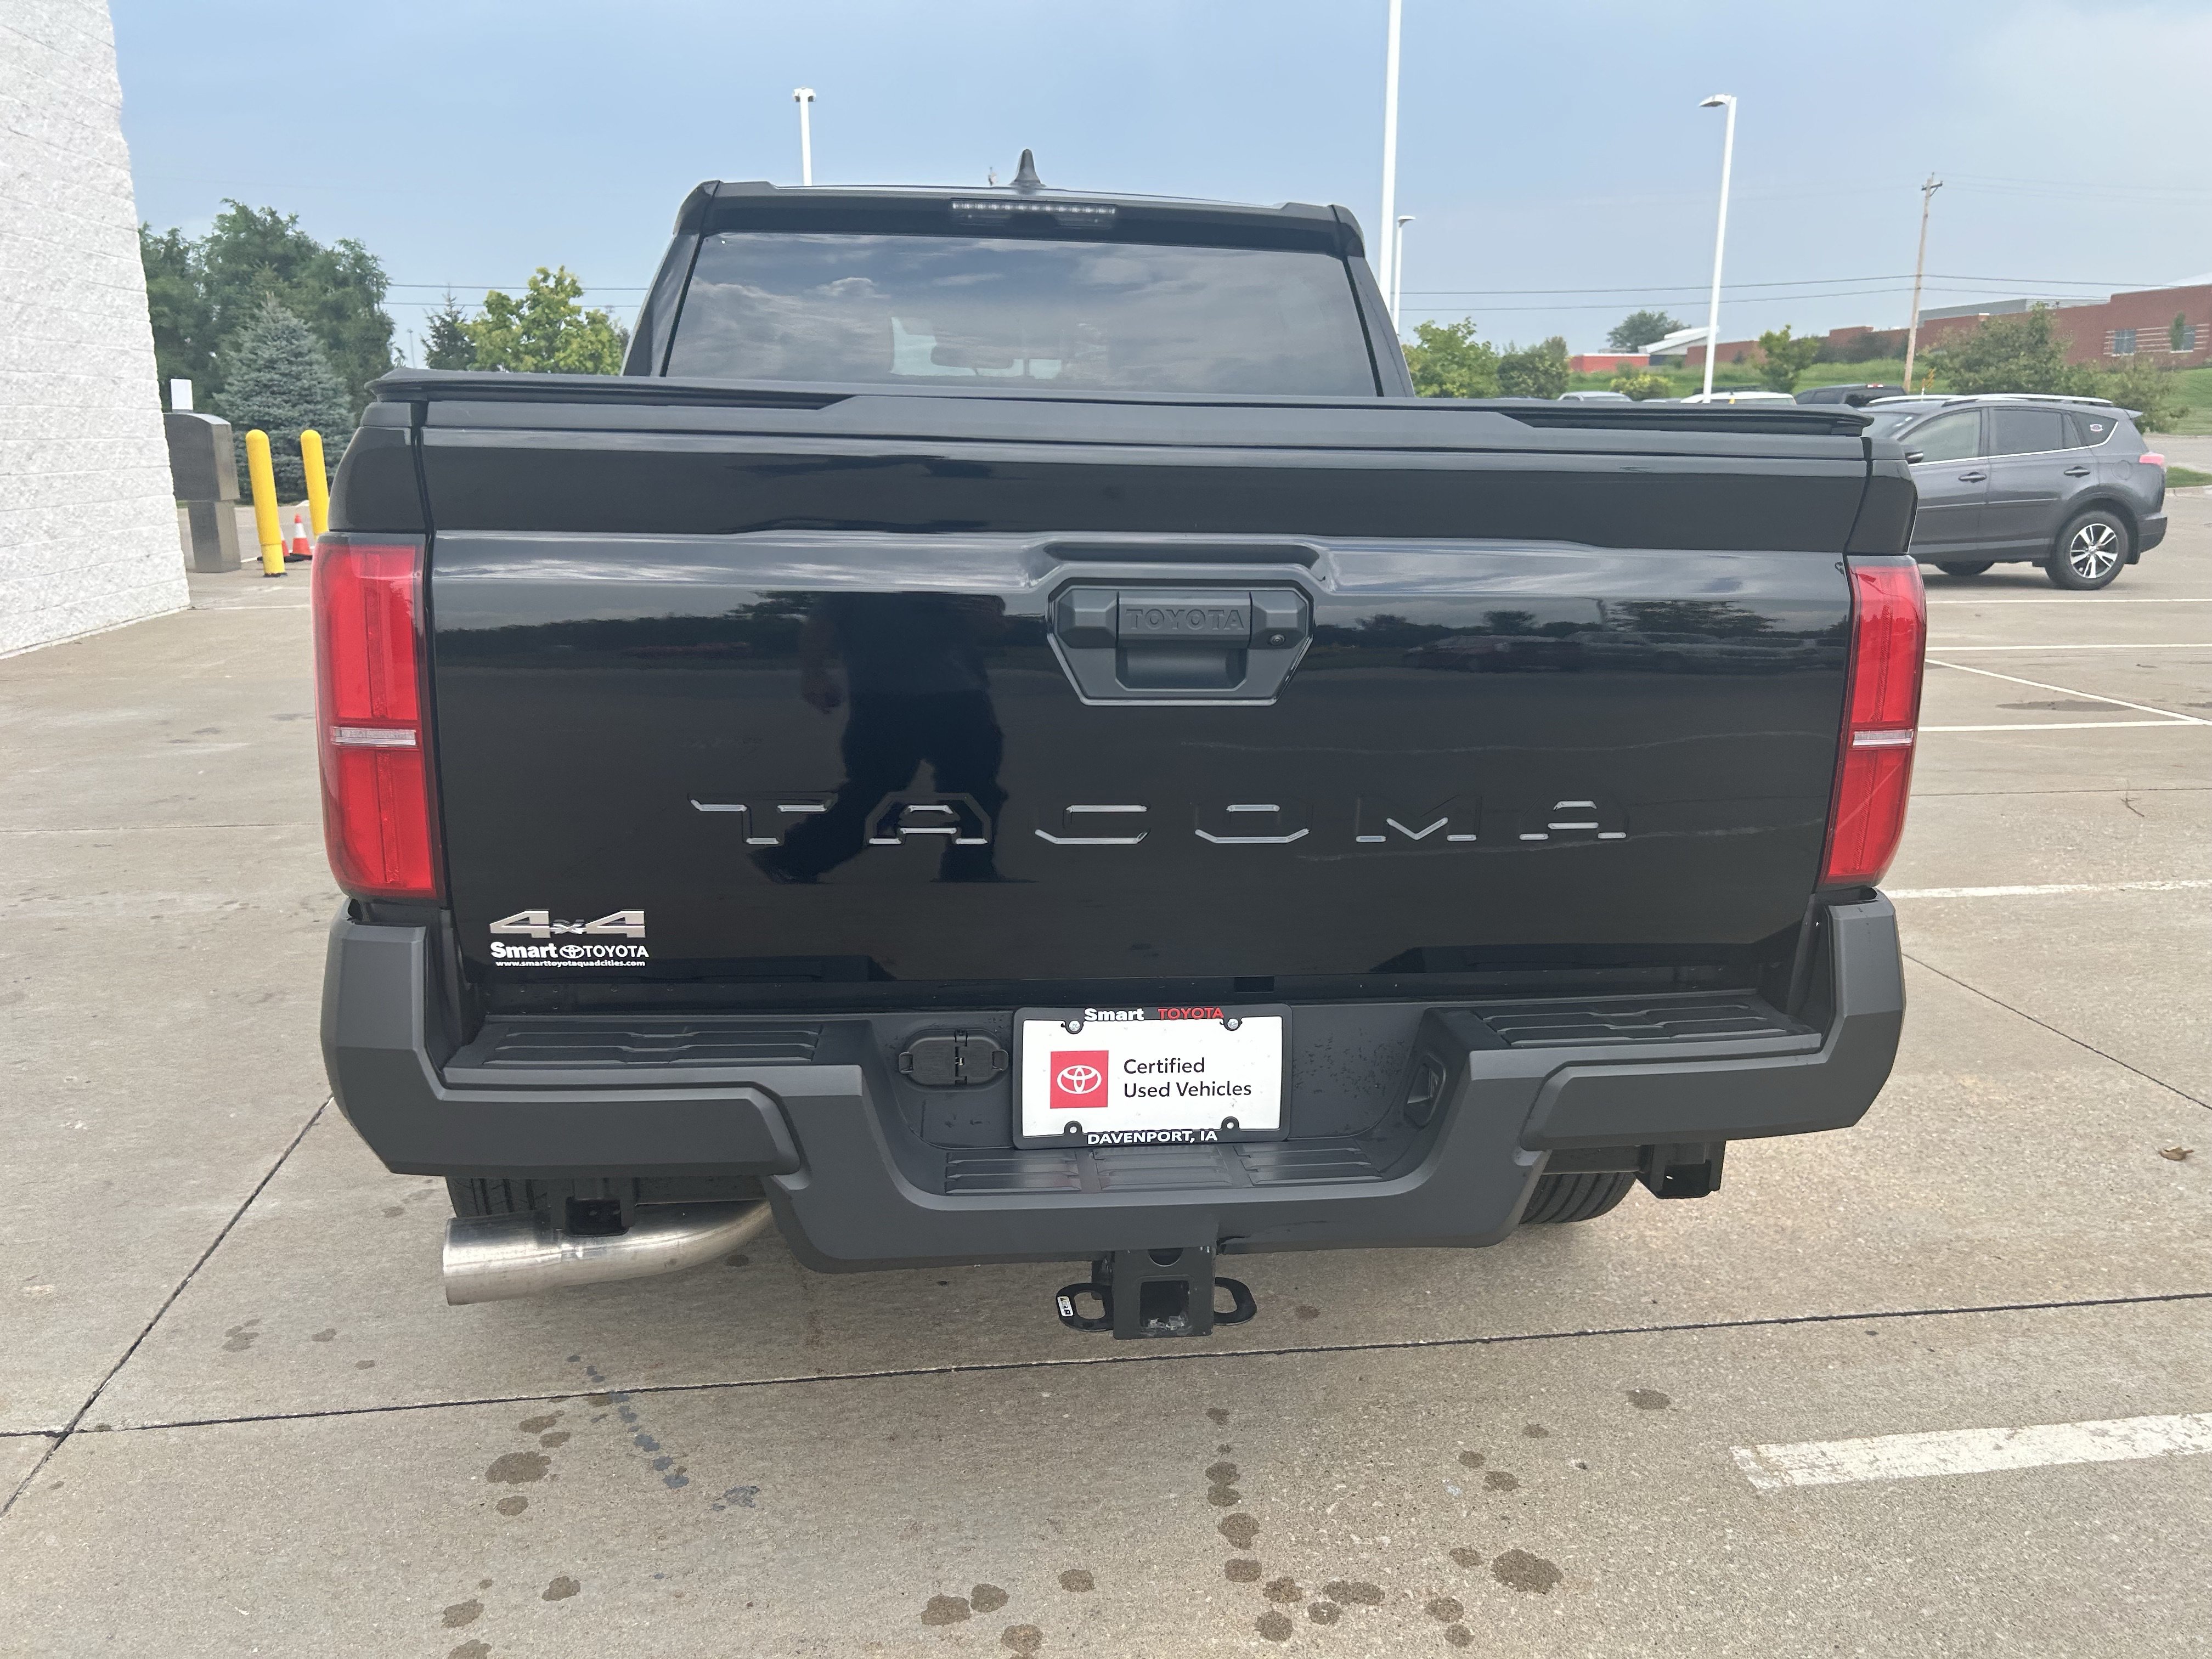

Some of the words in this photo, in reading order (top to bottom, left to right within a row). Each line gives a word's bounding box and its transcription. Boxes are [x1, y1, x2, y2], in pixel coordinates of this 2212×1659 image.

[1126, 608, 1244, 630] TOYOTA
[690, 794, 1628, 846] TACOMA
[490, 941, 558, 958] Smart
[583, 945, 650, 958] TOYOTA
[495, 960, 646, 968] www.smarttoyotaquadcities.com
[1084, 1008, 1144, 1022] Smart
[1158, 1007, 1224, 1020] TOYOTA
[1124, 1057, 1205, 1074] Certified
[1124, 1081, 1171, 1098] Used
[1176, 1080, 1252, 1097] Vehicles
[1087, 1131, 1195, 1145] DAVENPORT,
[1200, 1130, 1218, 1142] IA
